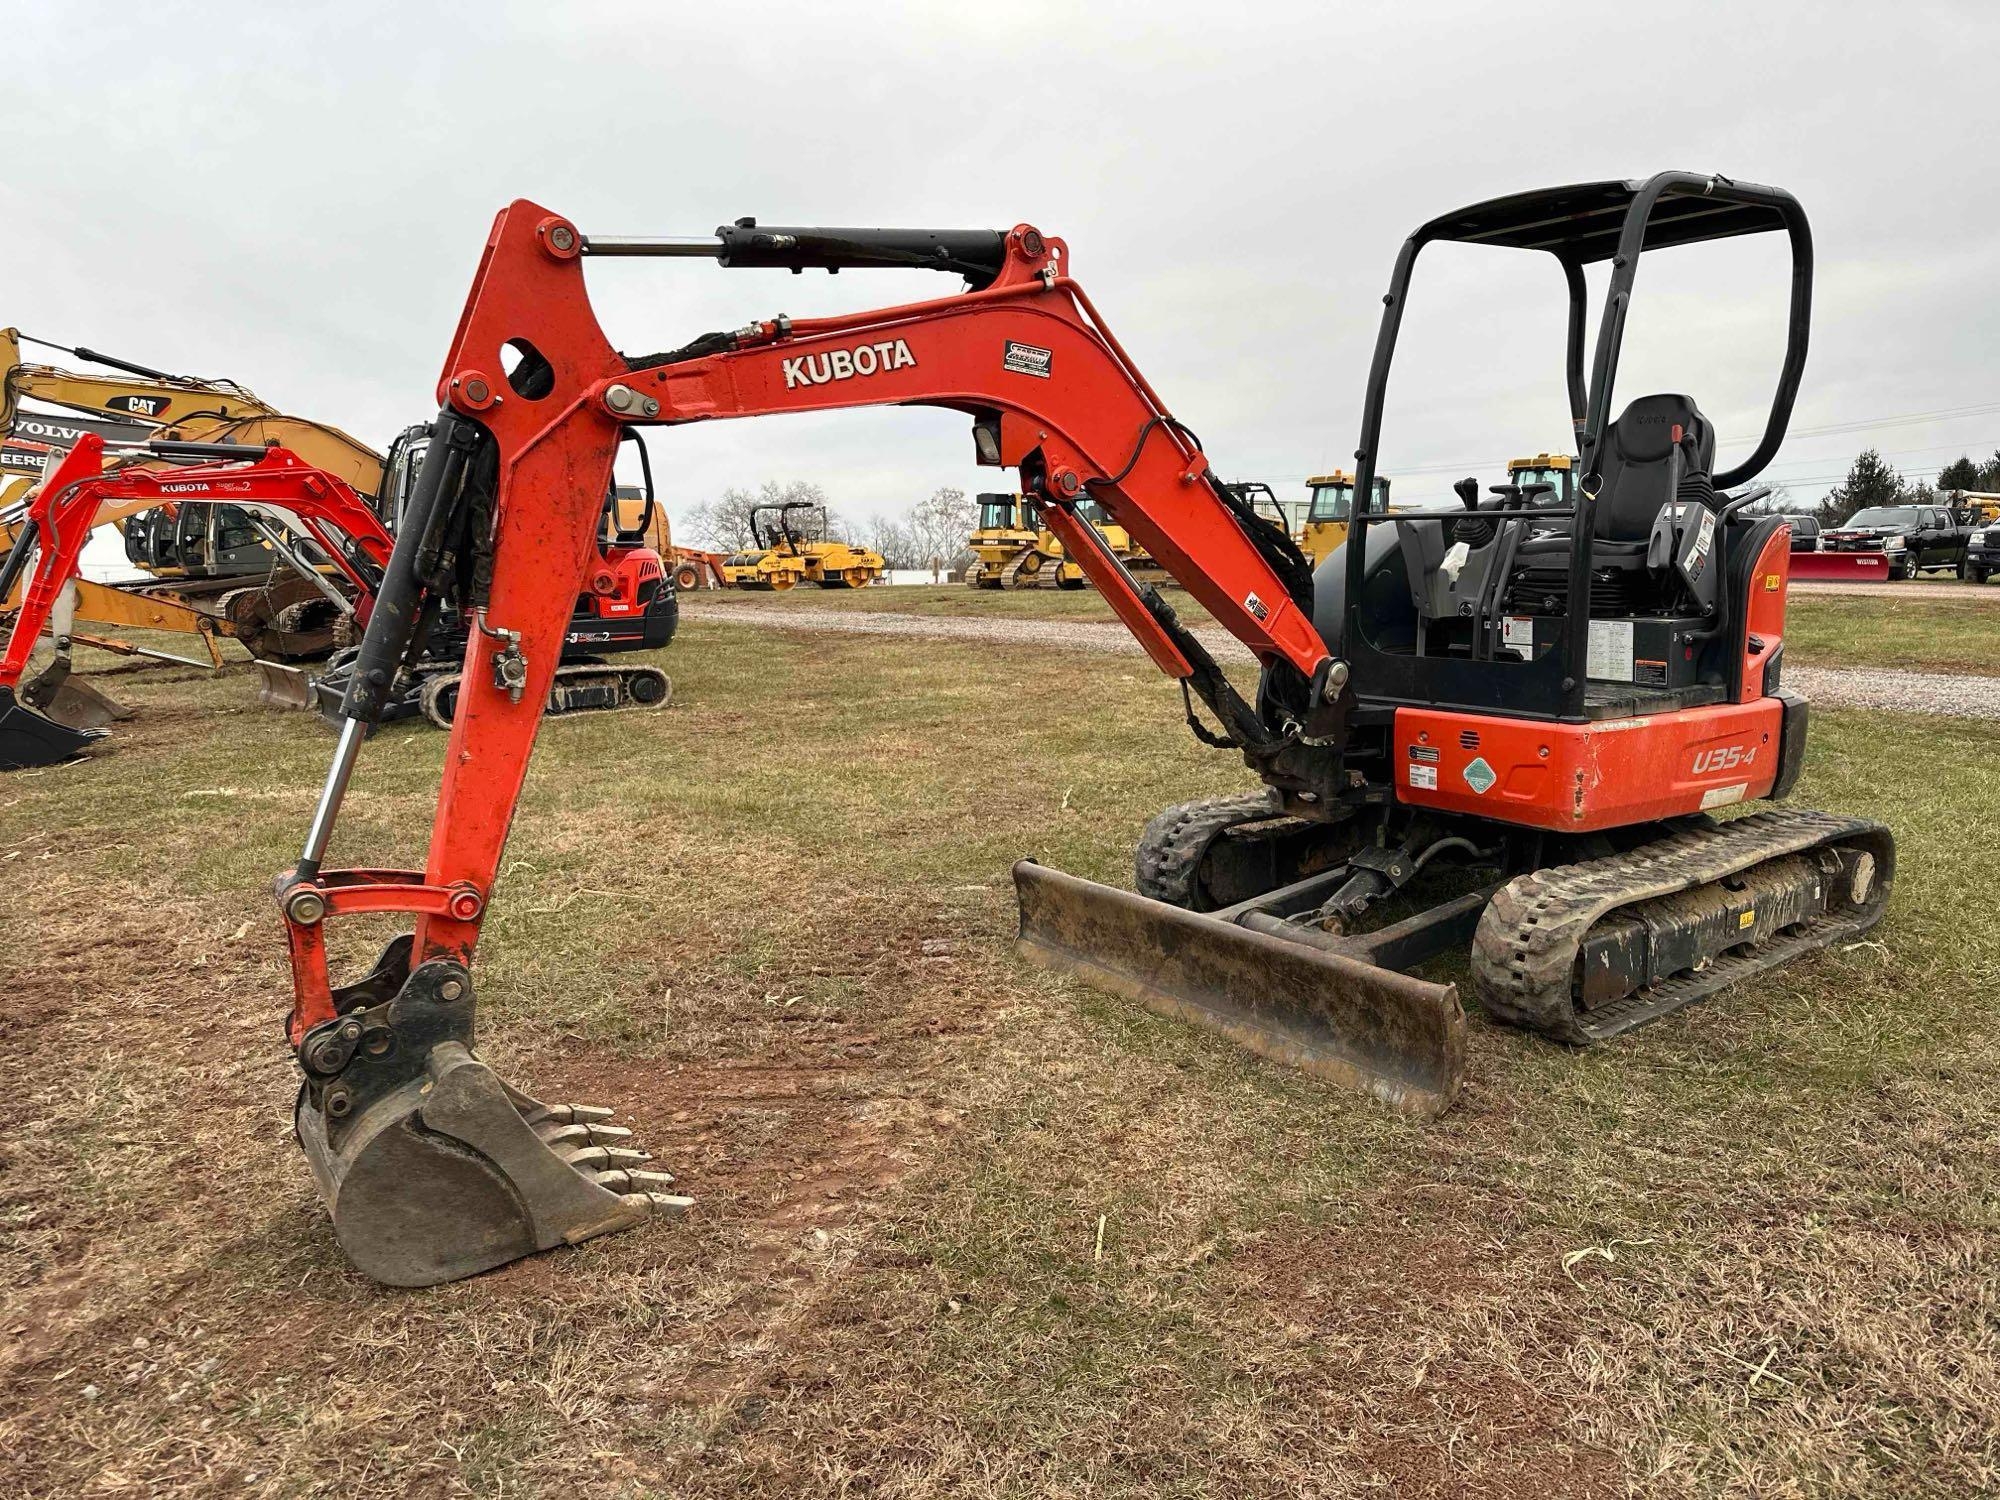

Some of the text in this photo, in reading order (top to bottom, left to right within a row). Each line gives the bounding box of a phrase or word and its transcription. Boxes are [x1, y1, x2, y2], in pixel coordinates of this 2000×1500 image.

[782, 339, 917, 388] KUBOTA
[128, 396, 156, 416] CAT
[160, 483, 210, 493] KUBOTA
[1691, 745, 1757, 775] U35-4
